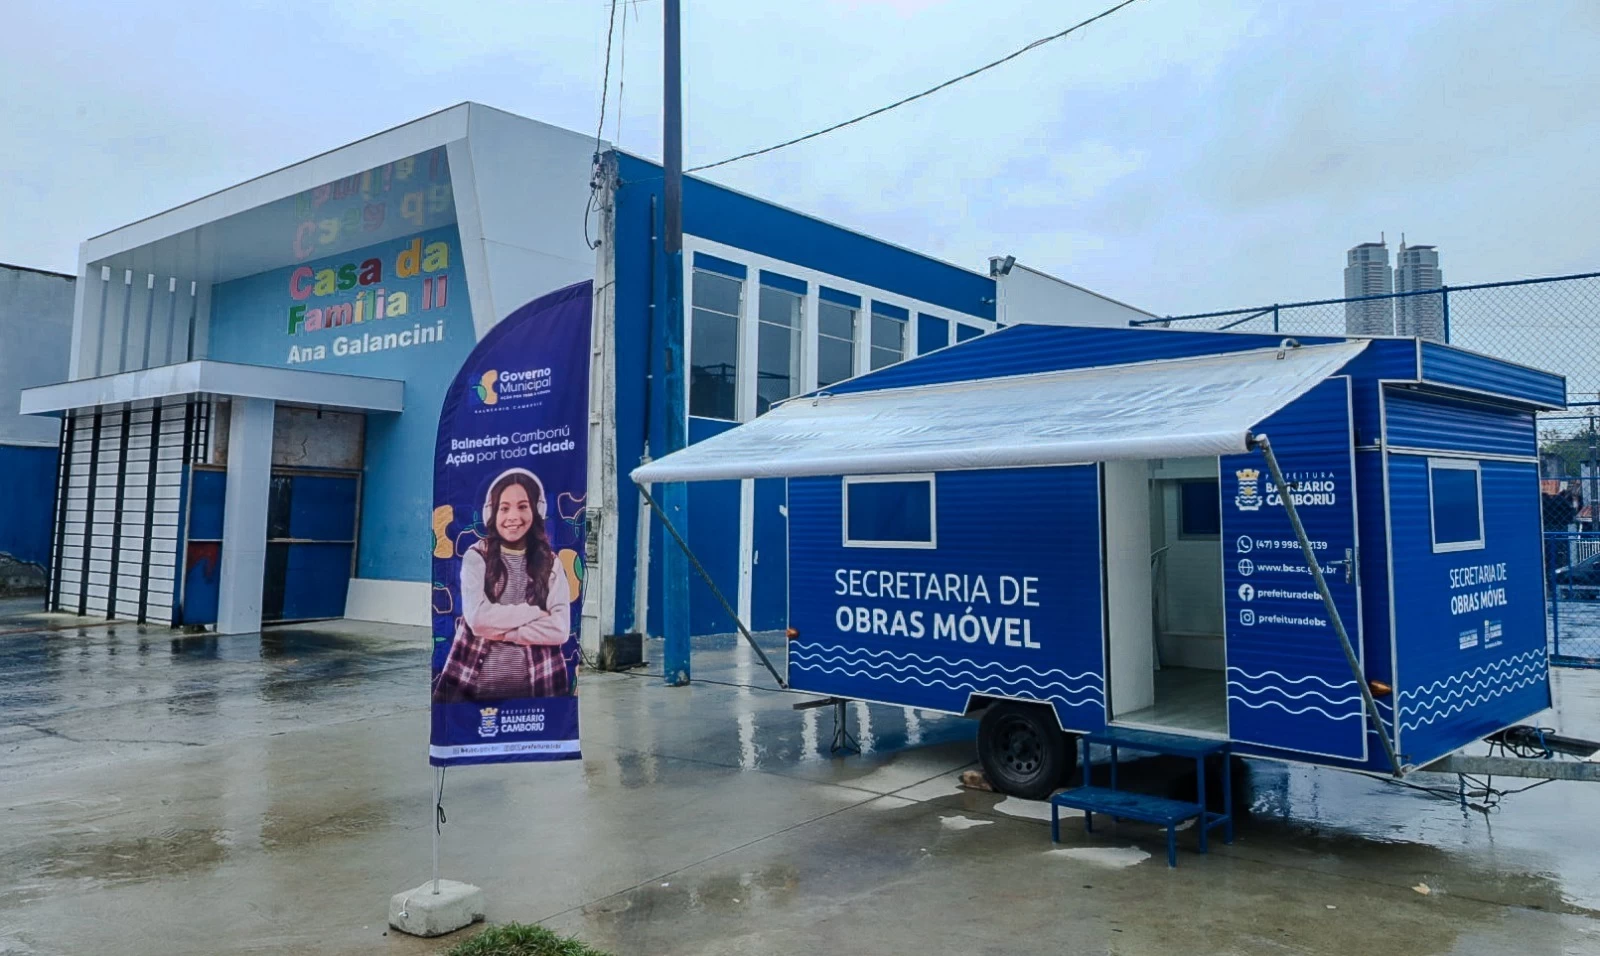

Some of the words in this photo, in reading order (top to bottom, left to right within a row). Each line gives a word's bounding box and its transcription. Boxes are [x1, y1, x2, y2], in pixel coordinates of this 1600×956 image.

[289, 257, 382, 300] Casa
[396, 238, 449, 278] da
[287, 288, 409, 335] Família
[287, 344, 326, 364] Ana
[333, 320, 443, 357] Galancini
[500, 368, 551, 382] Governo
[500, 377, 552, 393] Municipal
[451, 434, 509, 450] Balneário
[510, 425, 570, 444] Camboriú
[445, 453, 475, 467] Ação
[476, 451, 497, 464] por
[500, 446, 527, 460] toda
[529, 439, 575, 455] Cidade
[1265, 472, 1335, 480] PFEITURA
[1265, 480, 1335, 493] BANEÁRIO
[1256, 540, 1273, 549] (47)
[1273, 540, 1280, 549] 9
[1257, 563, 1337, 575] www.bc.sc.gv.br
[1449, 564, 1497, 589] SECRETARIA
[1496, 562, 1507, 581] DE
[835, 568, 991, 604] SECRETARIA
[1000, 575, 1040, 607] DE
[1450, 592, 1479, 615] OBRAS
[1480, 584, 1507, 609] MÓVEL
[836, 606, 925, 639] OBRAS
[933, 606, 1041, 649] MÓVEL
[1258, 614, 1327, 627] prefeituradebc
